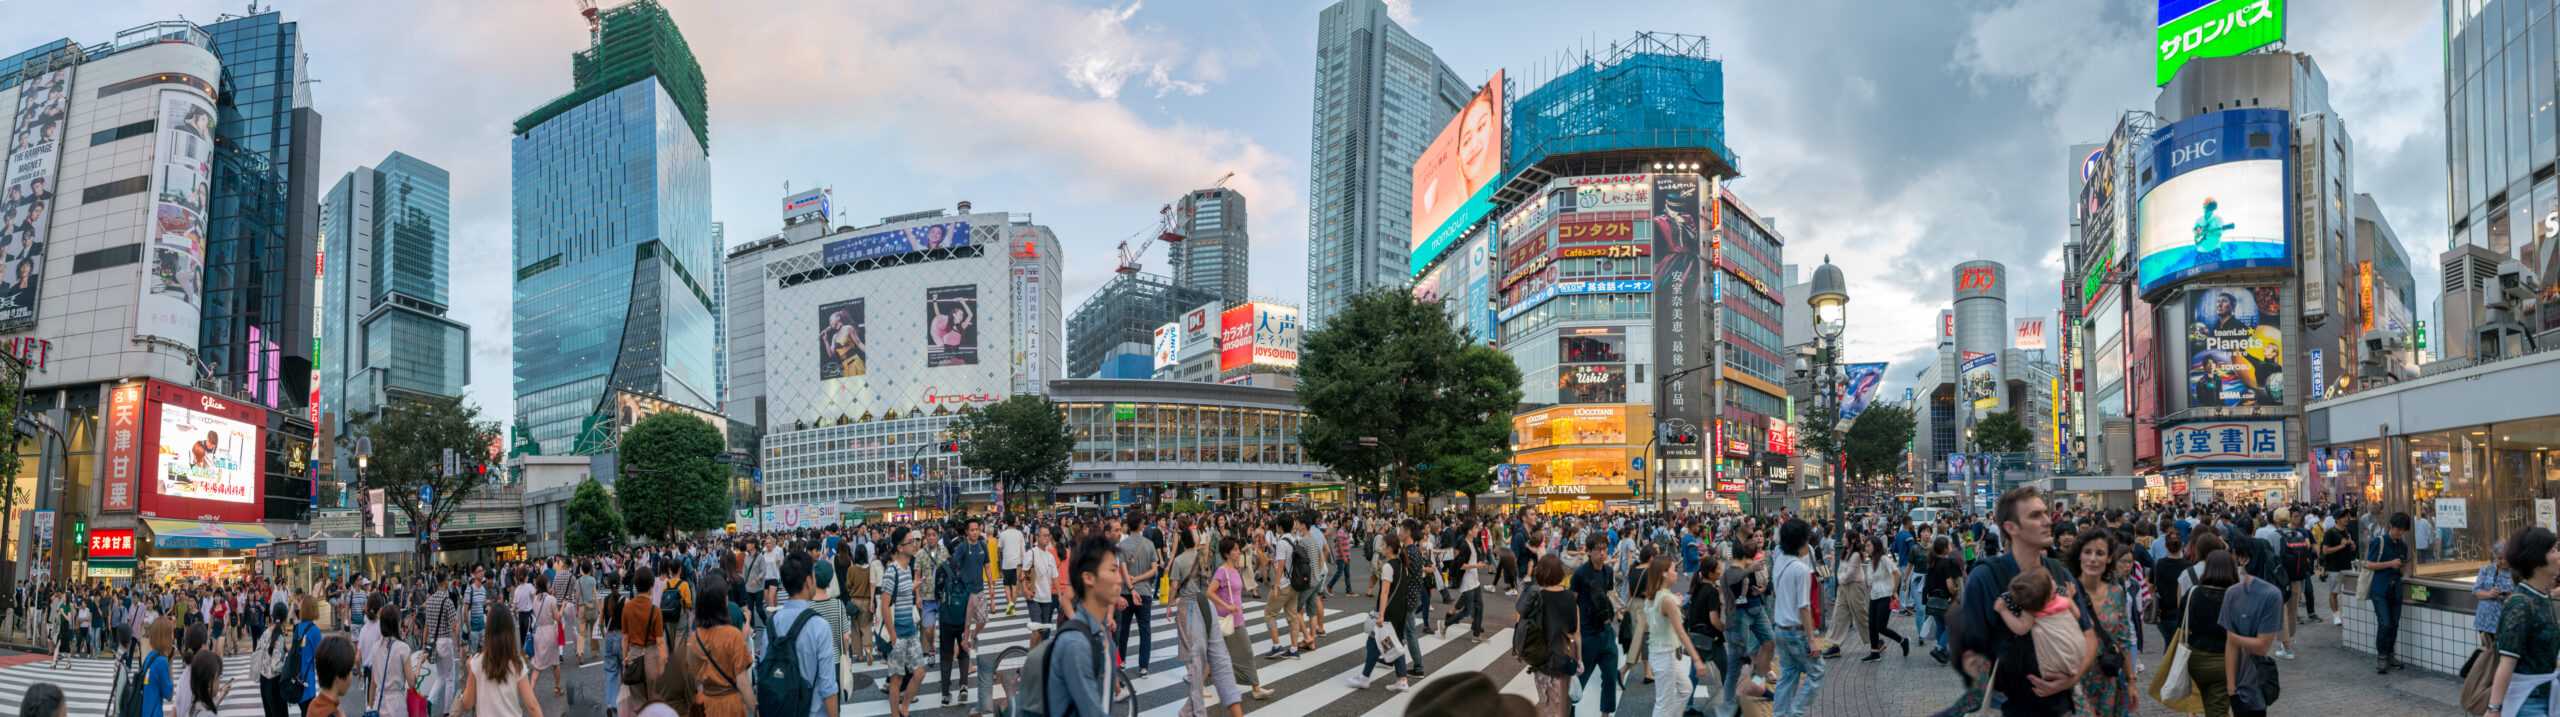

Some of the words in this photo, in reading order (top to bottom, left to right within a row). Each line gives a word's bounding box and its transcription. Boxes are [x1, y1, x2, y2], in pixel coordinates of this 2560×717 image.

[2160, 0, 2273, 61] サロンパス
[2171, 138, 2217, 168] DHC
[1569, 174, 1647, 186] しゃぶしゃぶバイキング
[1602, 189, 1648, 204] しゃぶ葉
[1431, 208, 1469, 251] momopuri
[1559, 223, 1632, 238] コンタクト
[2304, 206, 2316, 260] neon
[1608, 244, 1643, 258] ガスト
[1529, 255, 1549, 275] ガスト
[1587, 281, 1652, 292] 英会話イーオン
[1958, 271, 1995, 293] 109
[1255, 310, 1296, 335] 大声
[2018, 320, 2042, 338] H&M
[1222, 322, 1253, 343] カラオケ
[2214, 329, 2247, 337] teamLab
[1222, 335, 1253, 352] JOYSOUND
[2206, 337, 2263, 350] Planets
[1254, 346, 1297, 360] JOYSOUND
[201, 395, 226, 411] Glico
[935, 393, 1000, 403] TOKYU
[2219, 391, 2255, 400] DMM.com
[1574, 408, 1614, 416] L'OCCITANE
[2165, 428, 2276, 457] 大盛堂書店
[110, 405, 134, 507] 天津甘栗
[1770, 466, 1787, 479] LUSH
[91, 535, 132, 550] 天津甘栗
[193, 562, 206, 570] TAX
[206, 561, 219, 570] Free
